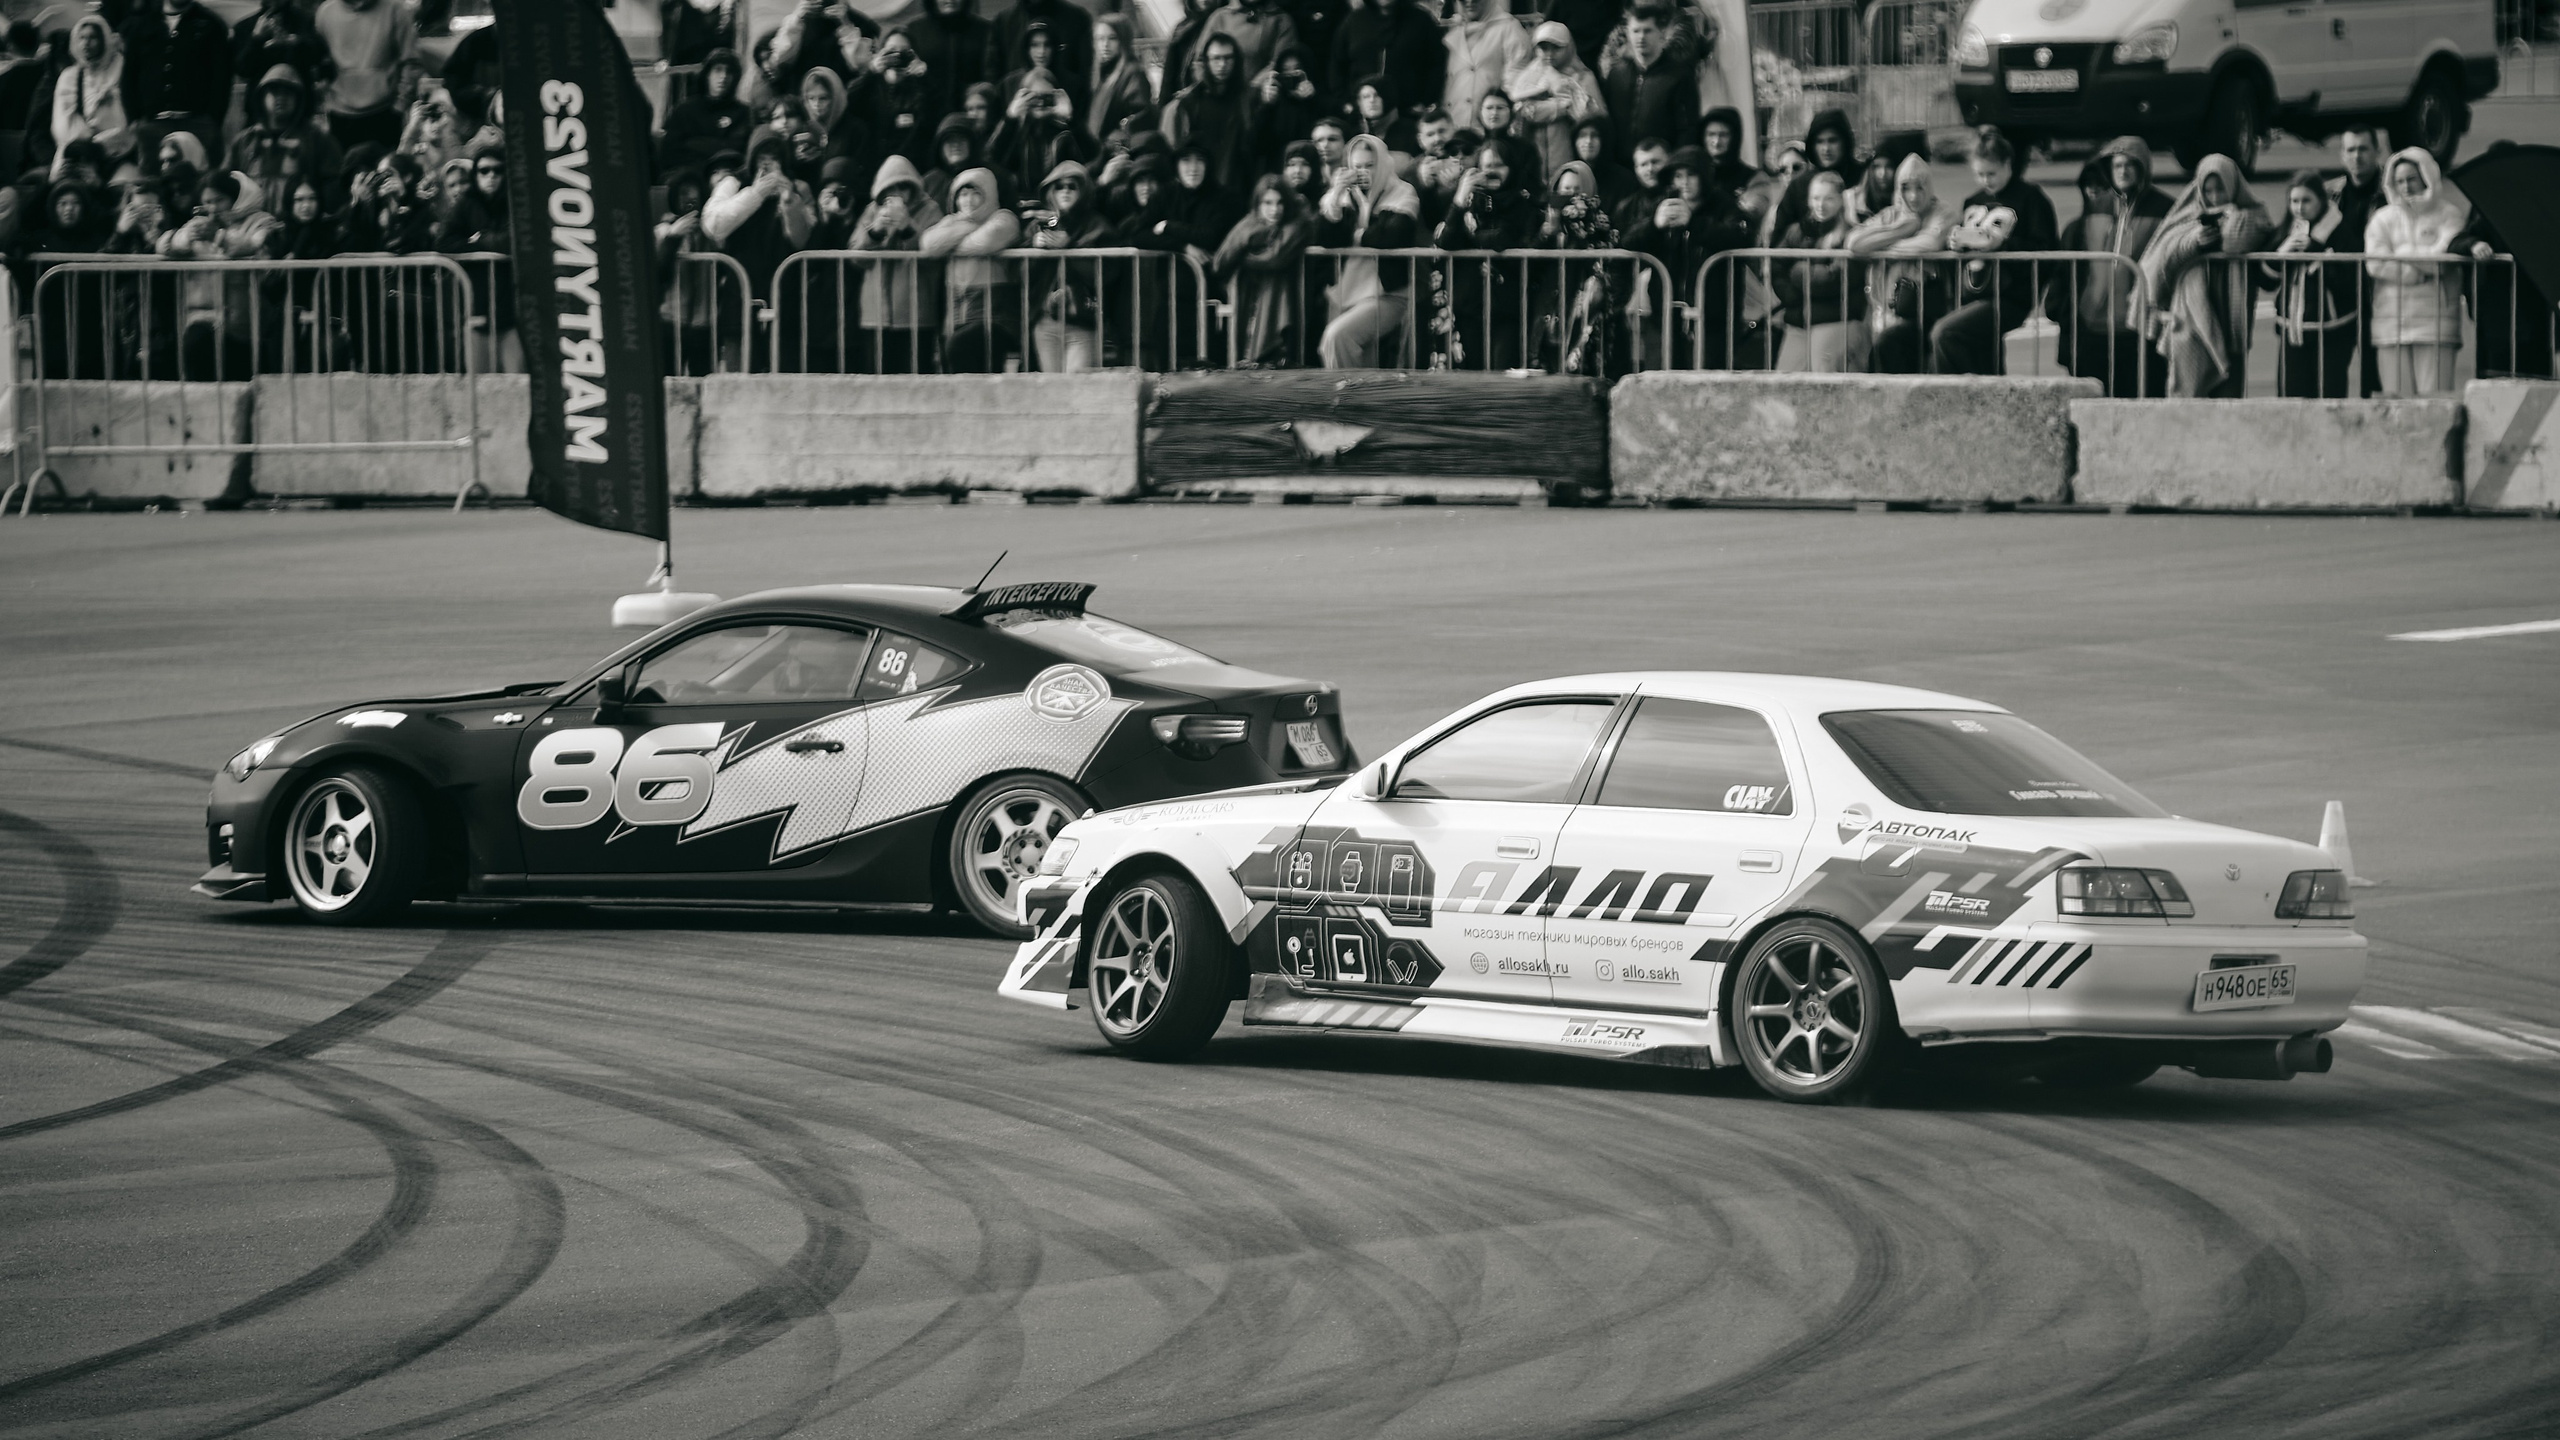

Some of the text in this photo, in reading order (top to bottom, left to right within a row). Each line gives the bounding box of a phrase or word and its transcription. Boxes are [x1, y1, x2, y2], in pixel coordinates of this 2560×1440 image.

[983, 582, 1086, 607] INTERCEPTOR
[878, 647, 908, 677] 86
[1315, 745, 1329, 758] 65
[517, 722, 726, 830] 86
[1868, 820, 1979, 842] АВТОПАК
[1947, 896, 1991, 910] PSR
[1464, 927, 1684, 952] магазин техники мировых брендов
[1623, 964, 1680, 981] allo.sakh
[2271, 969, 2289, 989] 65
[1591, 1024, 1646, 1040] PSR
